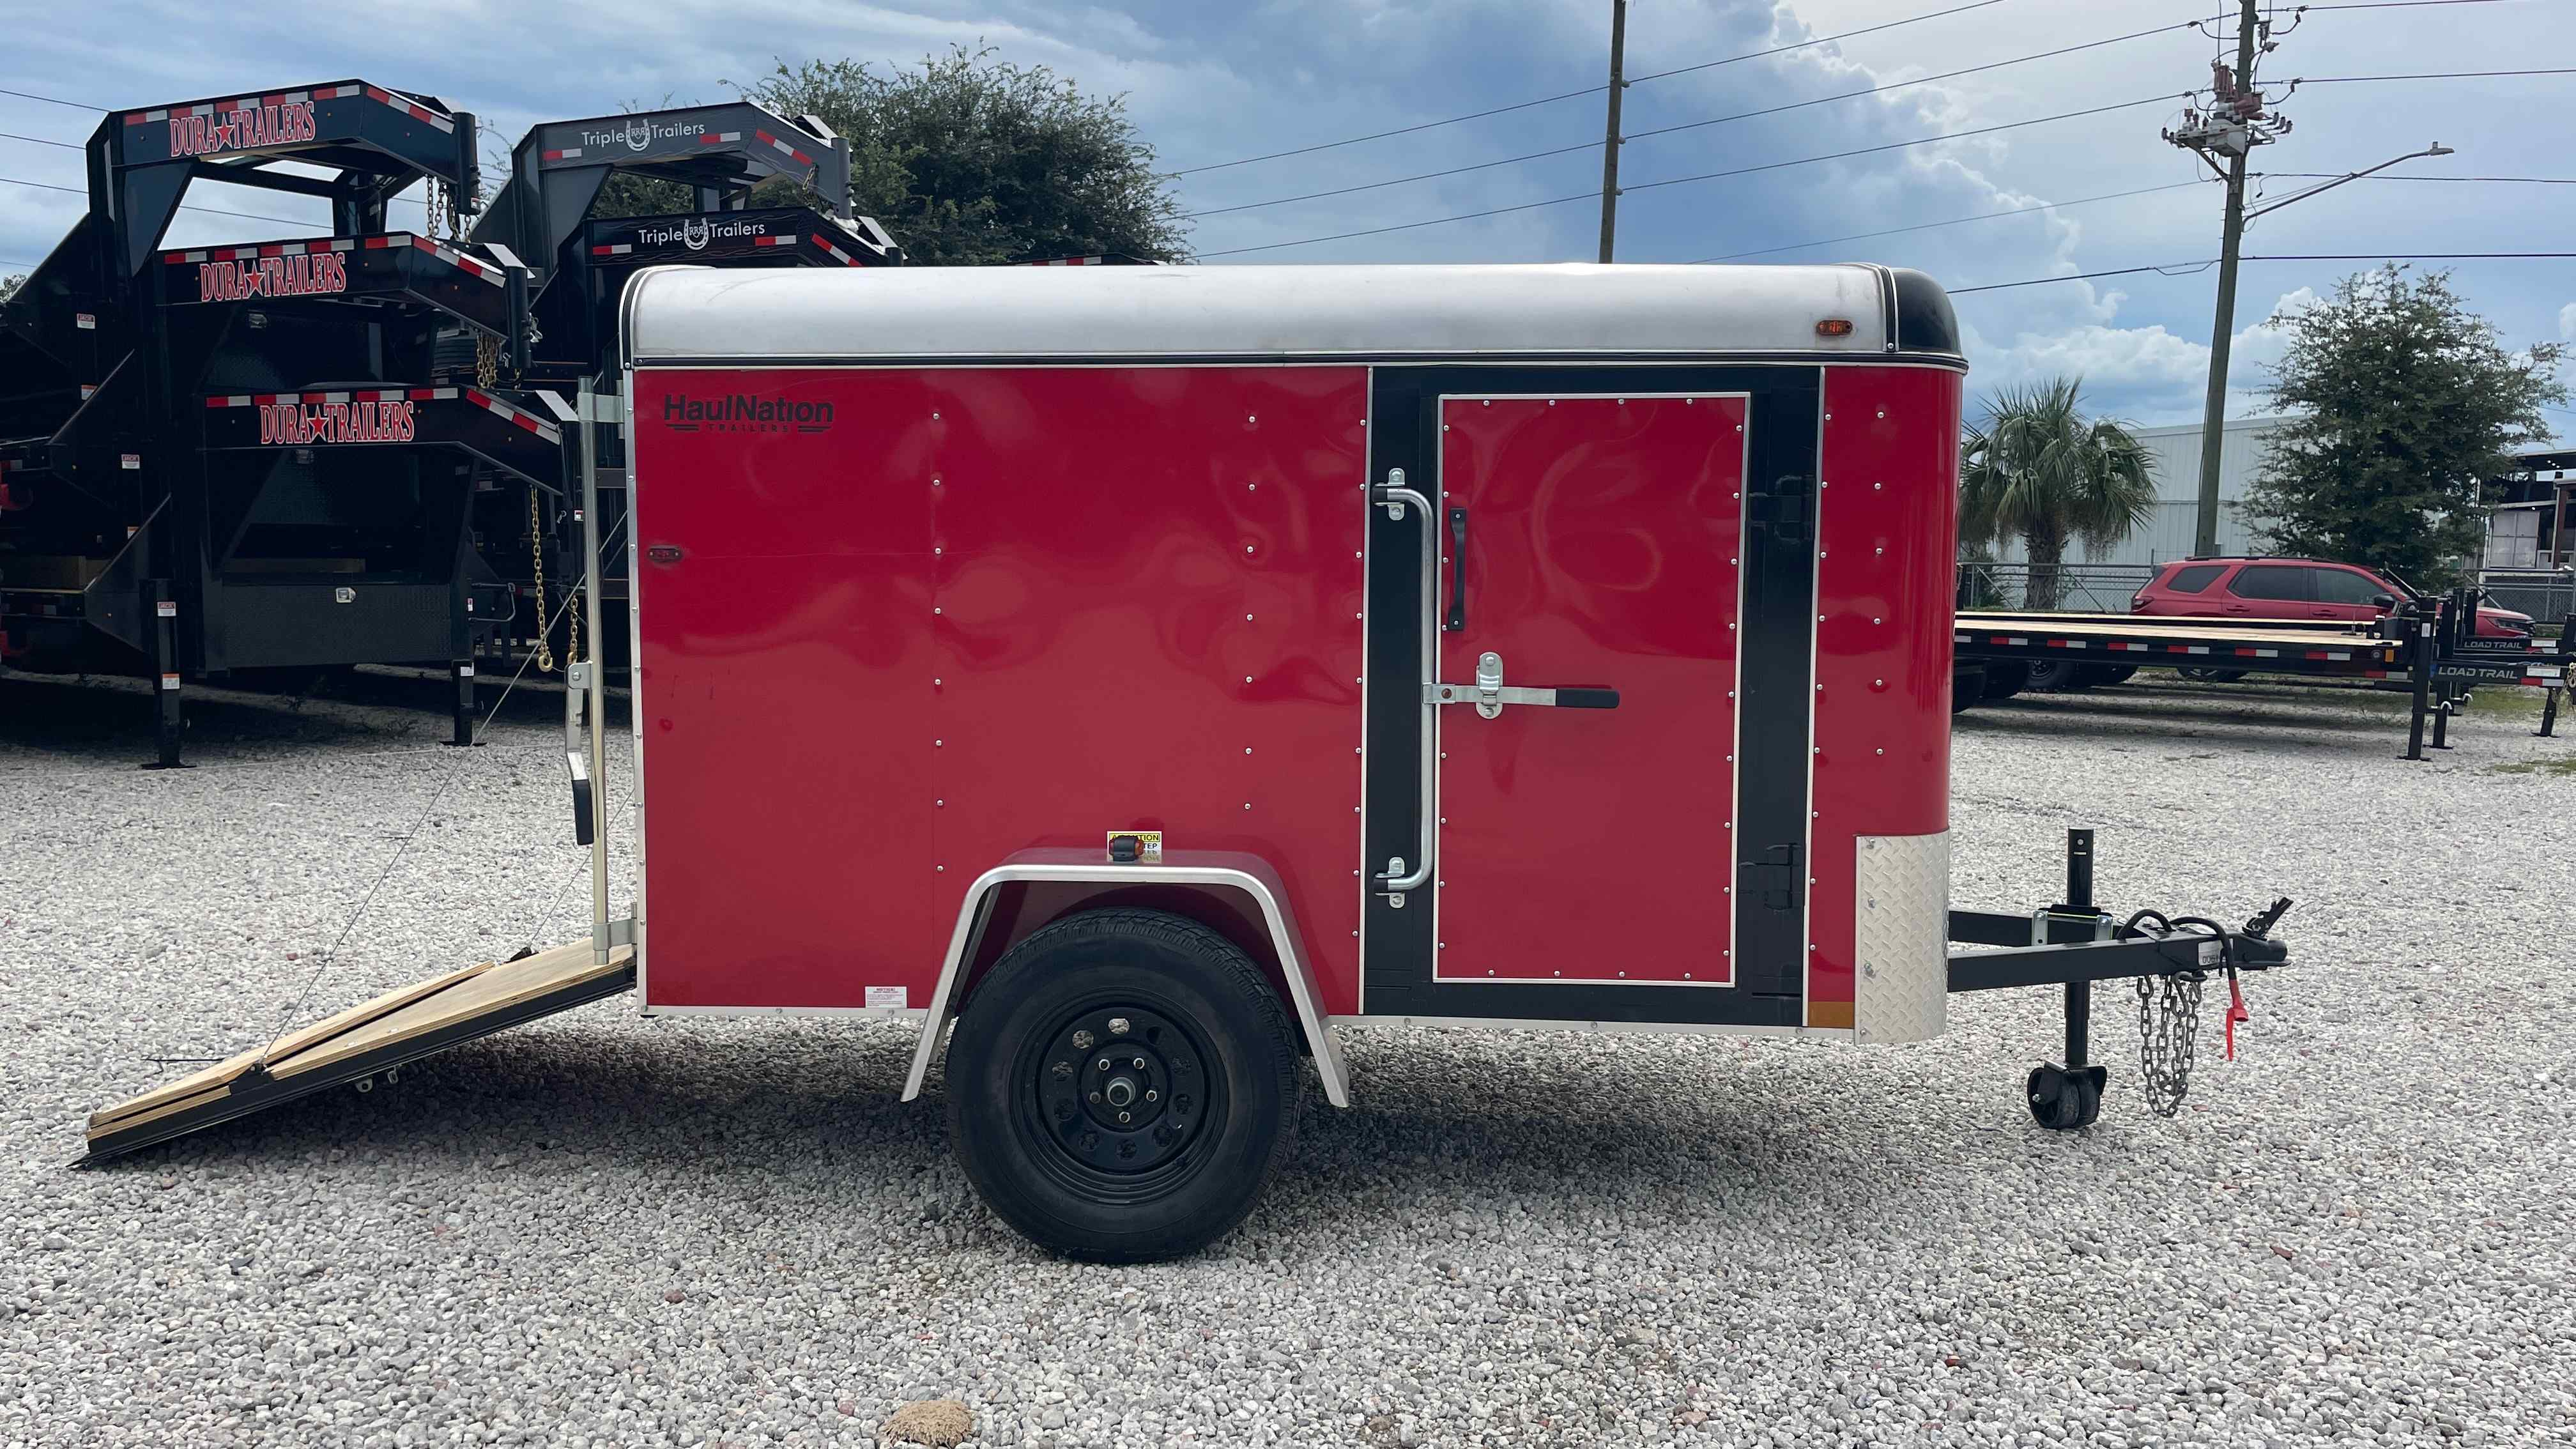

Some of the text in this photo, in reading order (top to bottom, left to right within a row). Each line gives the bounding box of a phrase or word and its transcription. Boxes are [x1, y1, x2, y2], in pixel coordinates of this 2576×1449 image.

[170, 101, 316, 157] DURA TRAILERS
[581, 130, 625, 148] Triple
[650, 122, 705, 138] Trailers
[639, 227, 683, 245] Triple
[710, 222, 765, 238] Trailers
[199, 252, 346, 302] DURA TRAILERS
[664, 394, 834, 422] HaulNation
[260, 401, 415, 444] DURA TRAILERS
[707, 424, 788, 433] TRAILERS
[2439, 666, 2476, 675] LOAD
[2478, 668, 2518, 679] TRAIL
